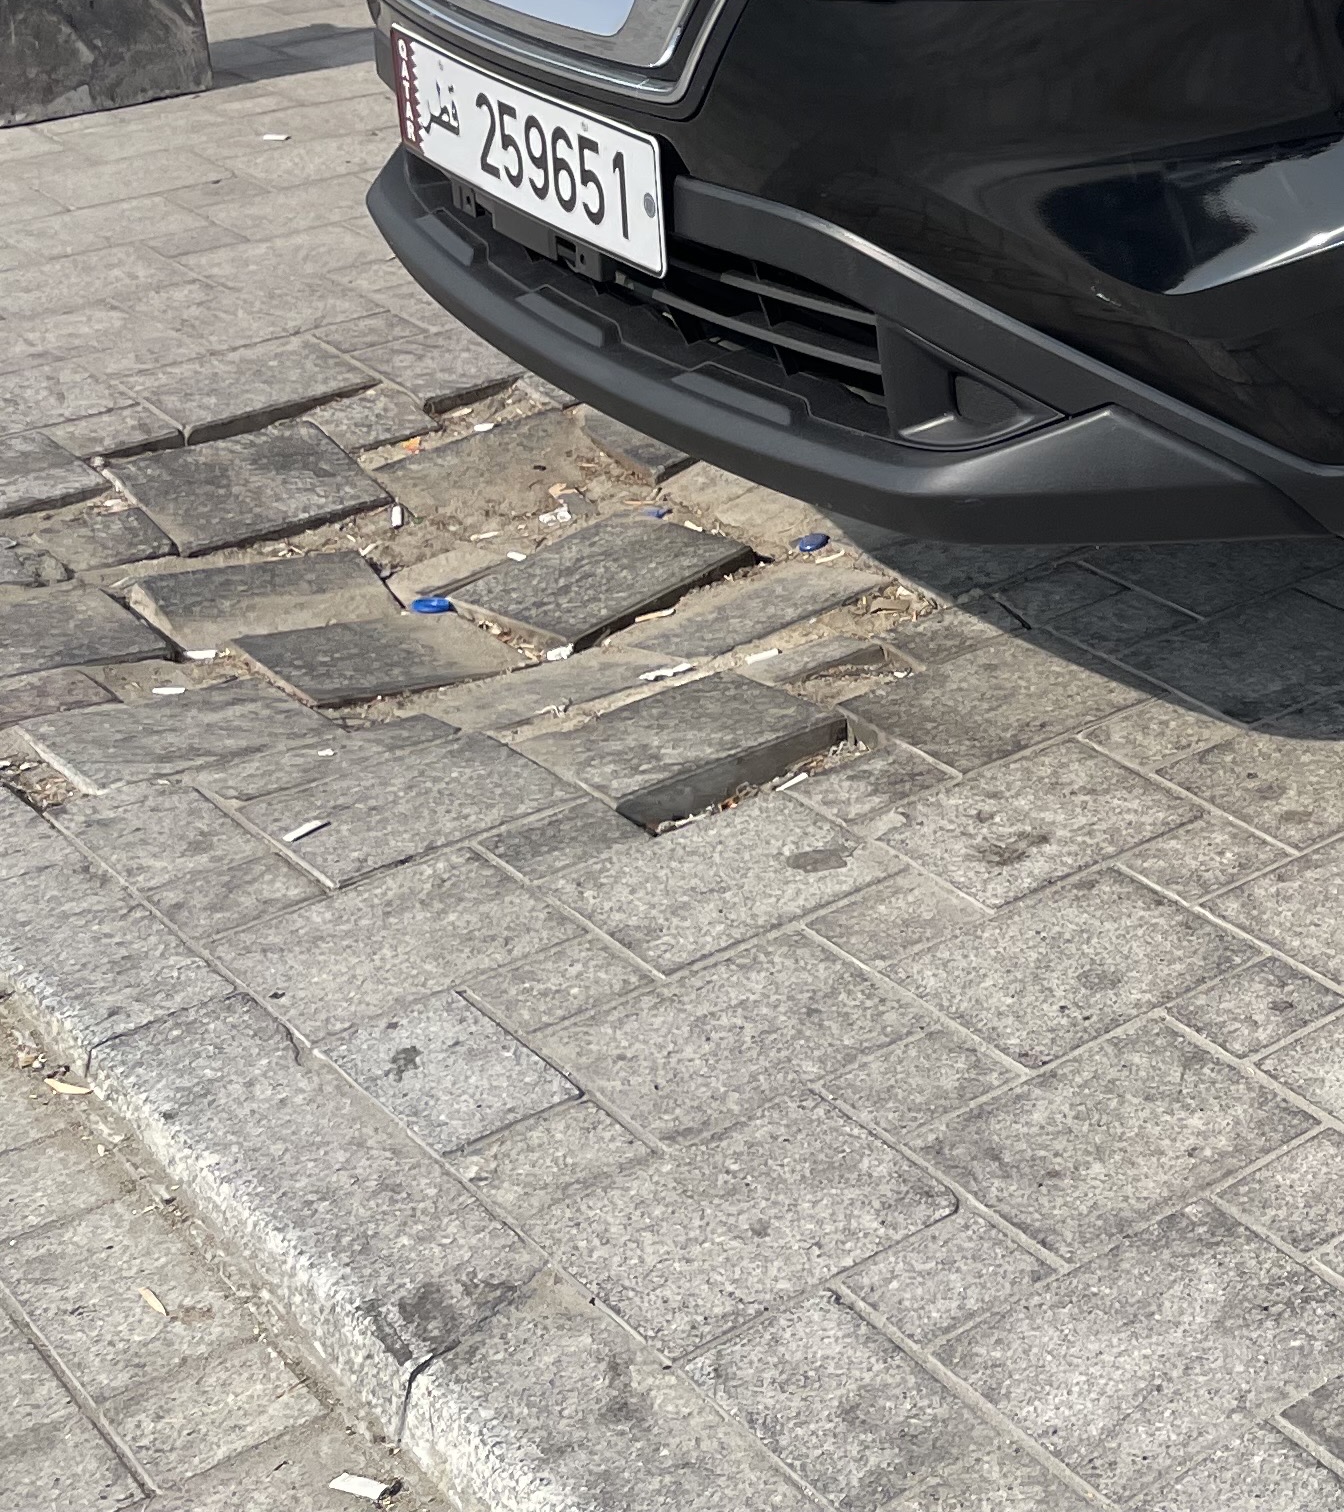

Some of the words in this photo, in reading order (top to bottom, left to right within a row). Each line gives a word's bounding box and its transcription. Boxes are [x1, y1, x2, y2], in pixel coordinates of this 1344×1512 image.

[396, 38, 417, 143] QATAR
[419, 78, 461, 136] قطر
[475, 92, 630, 240] 259651
